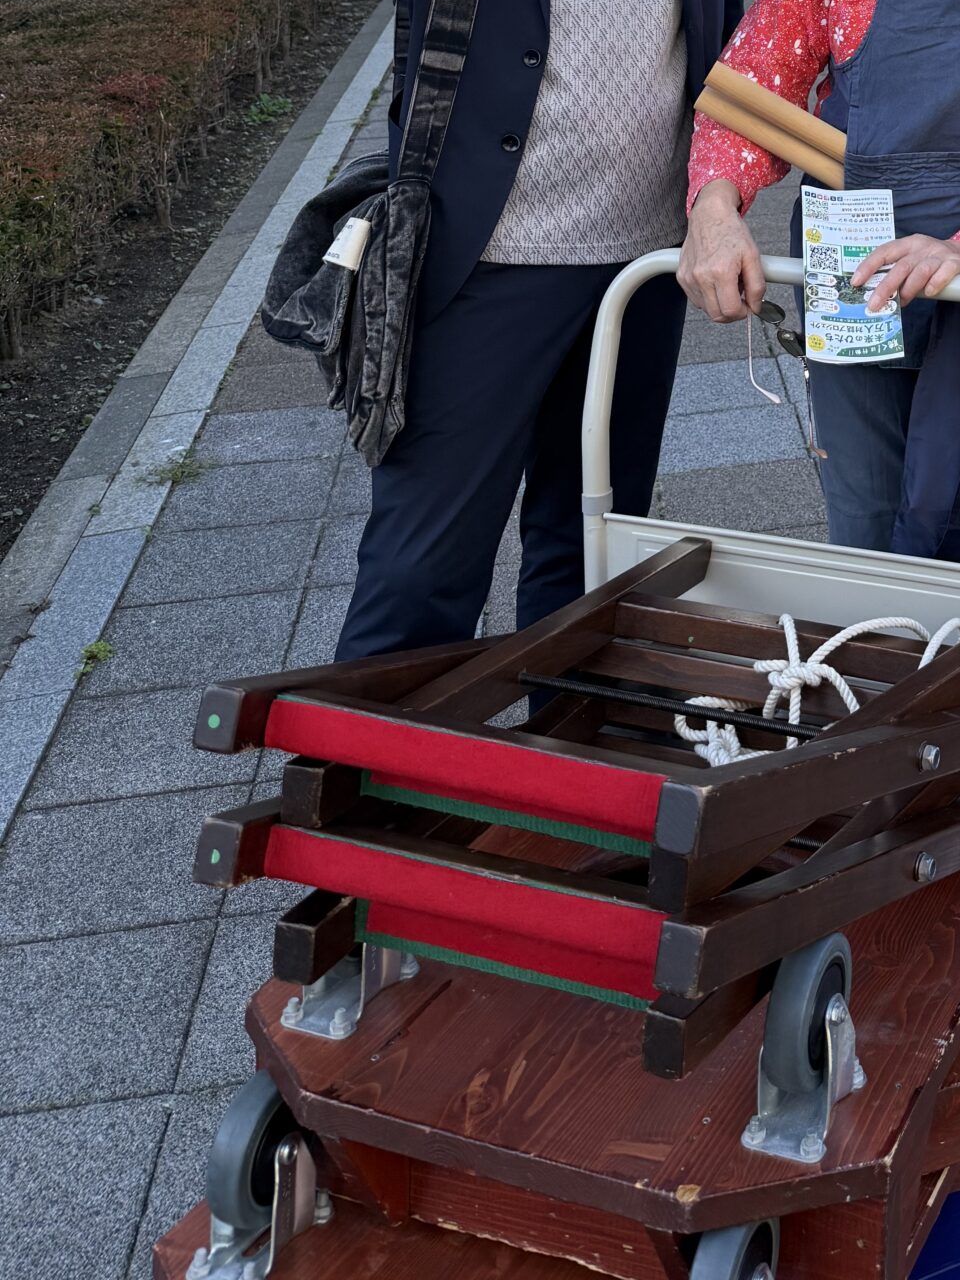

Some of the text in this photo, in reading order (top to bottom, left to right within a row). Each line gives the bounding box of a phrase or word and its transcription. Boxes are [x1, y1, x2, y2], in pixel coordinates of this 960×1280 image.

[825, 332, 884, 344] 未来のひたち
